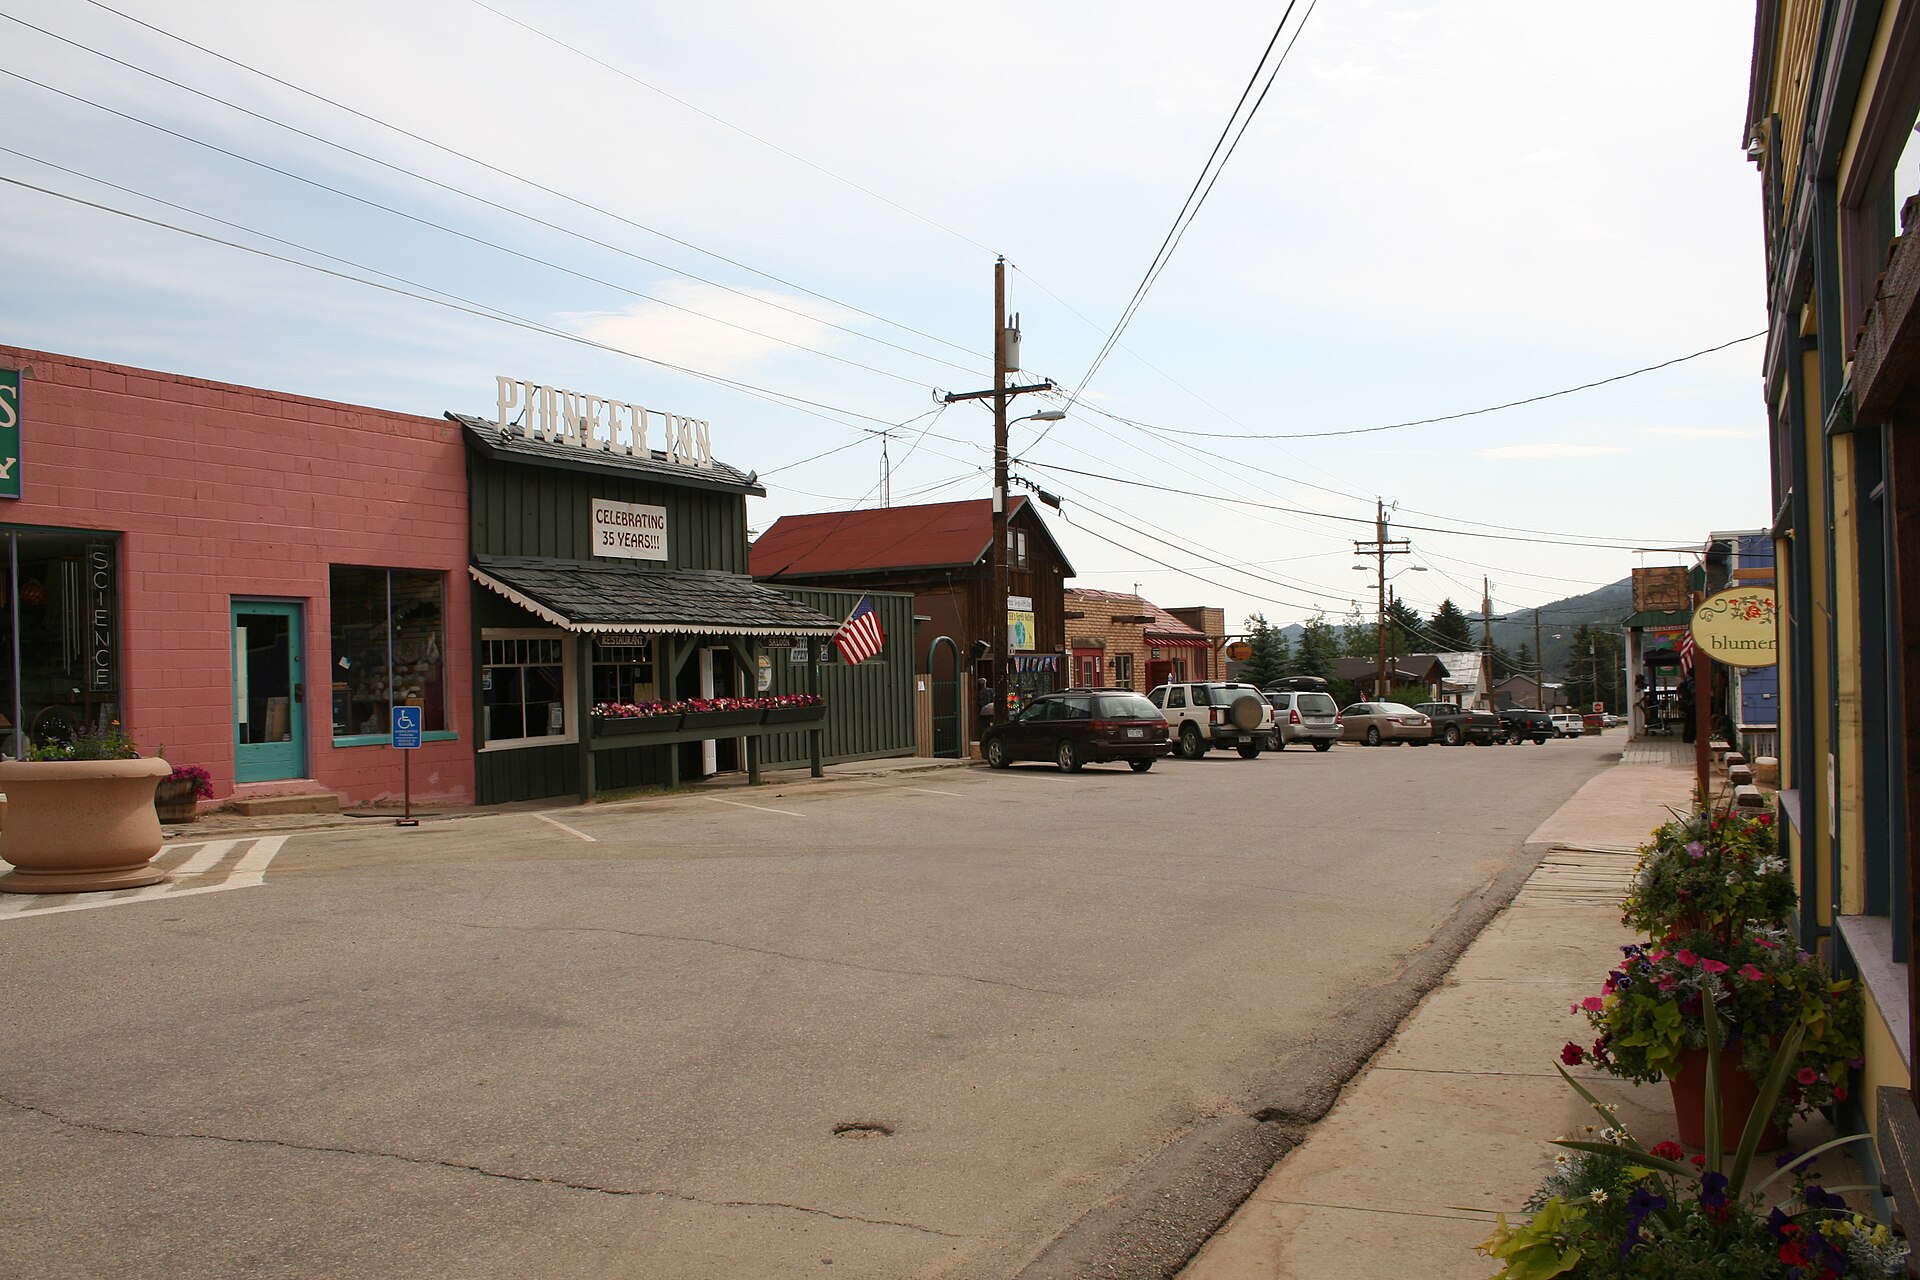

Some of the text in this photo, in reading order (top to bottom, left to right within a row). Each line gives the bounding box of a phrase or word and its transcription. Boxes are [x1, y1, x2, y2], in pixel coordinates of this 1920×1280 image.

[496, 375, 713, 469] PIONEER INN
[596, 509, 664, 530] CELEBRATING
[602, 531, 660, 549] 35 YEARS!!!
[92, 552, 110, 685] SCIENCE
[601, 635, 644, 645] RESTAURANT
[768, 638, 791, 646] SALOON
